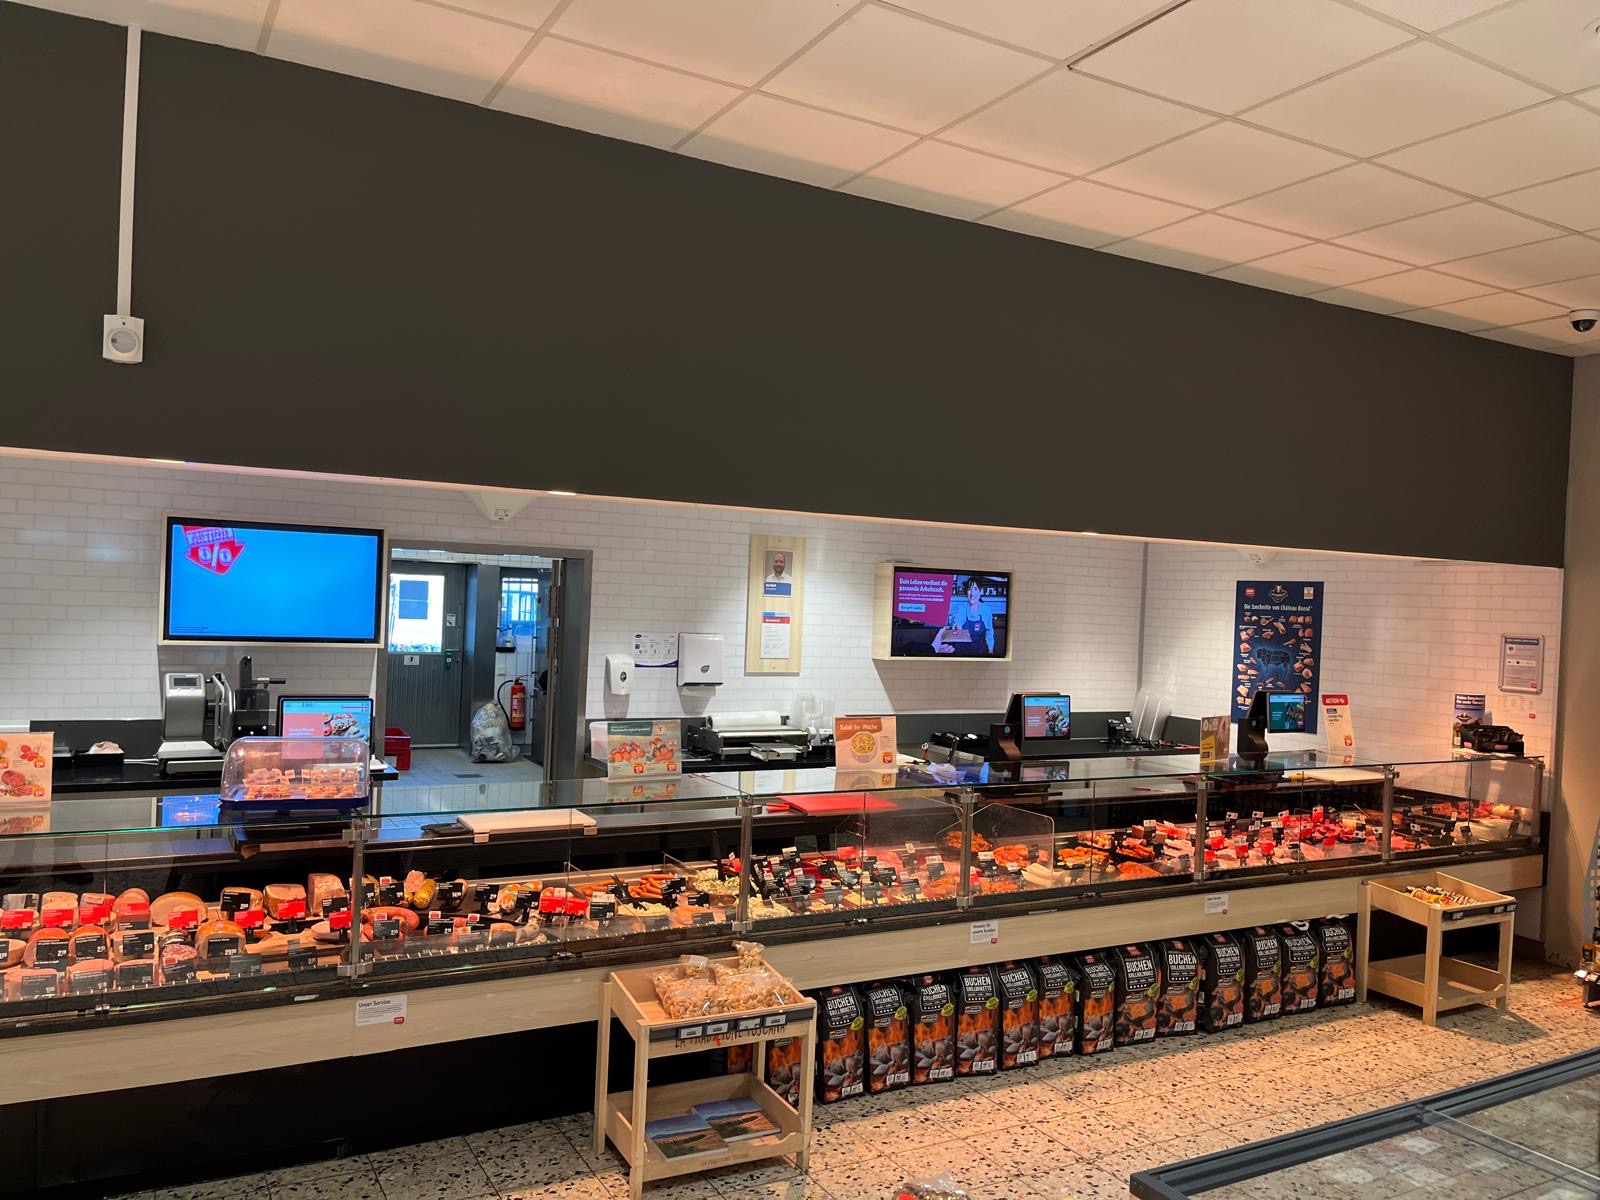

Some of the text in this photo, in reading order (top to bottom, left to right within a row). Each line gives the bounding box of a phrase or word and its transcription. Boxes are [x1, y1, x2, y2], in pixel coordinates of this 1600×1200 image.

[1125, 959, 1153, 973] BUCHEN
[1168, 954, 1197, 965] BUCHEN
[1084, 964, 1109, 974] BUCHEN
[964, 976, 991, 987] BUCHEN
[1001, 970, 1029, 983] BUCHEN
[869, 987, 898, 1000] BUCHEN
[827, 995, 855, 1010] BUCHEN
